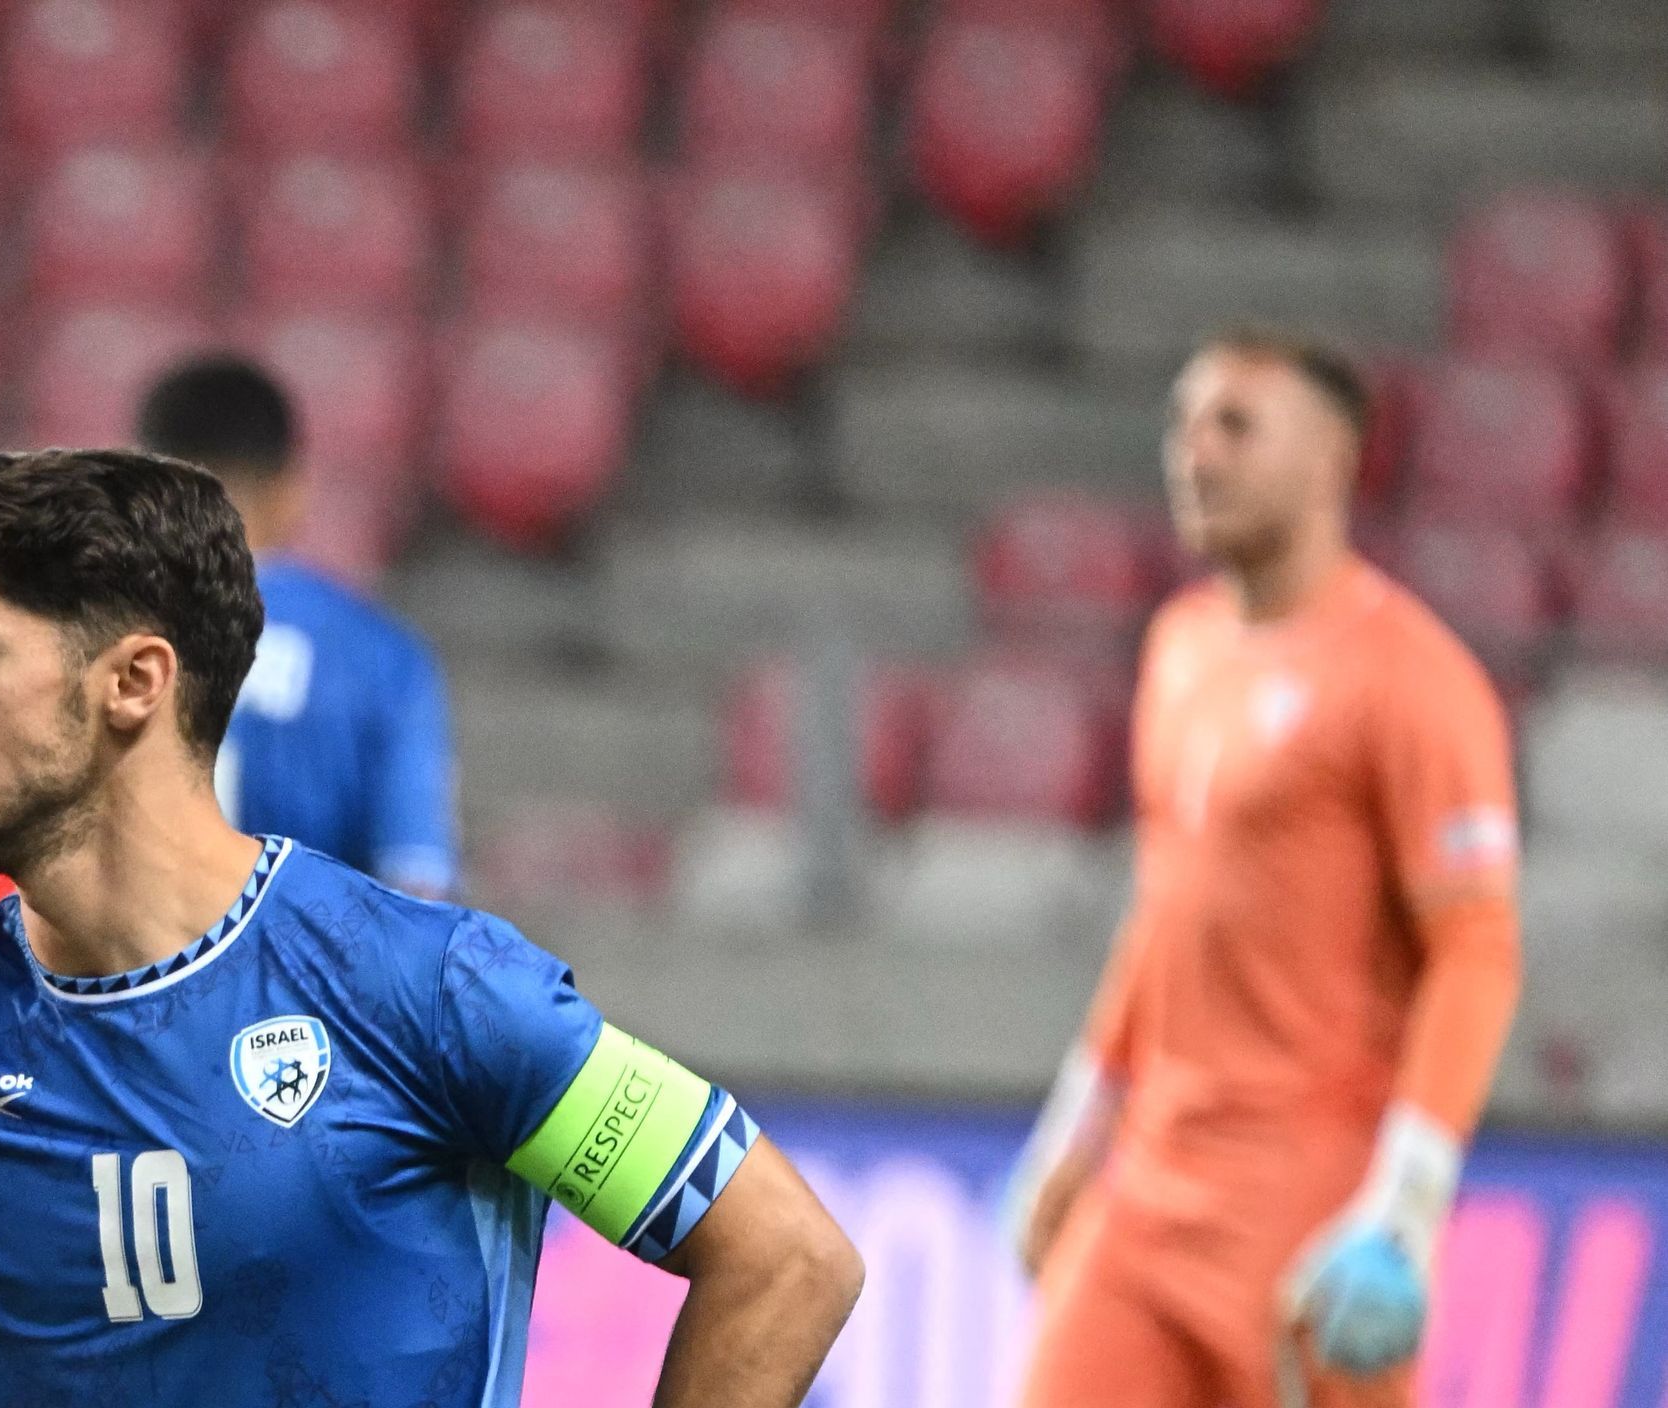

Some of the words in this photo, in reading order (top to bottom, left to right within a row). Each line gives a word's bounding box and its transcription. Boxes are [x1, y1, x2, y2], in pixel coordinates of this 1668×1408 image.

[250, 1026, 309, 1050] ISRAEL
[573, 1069, 655, 1183] RESPECT
[91, 1149, 203, 1322] 10
